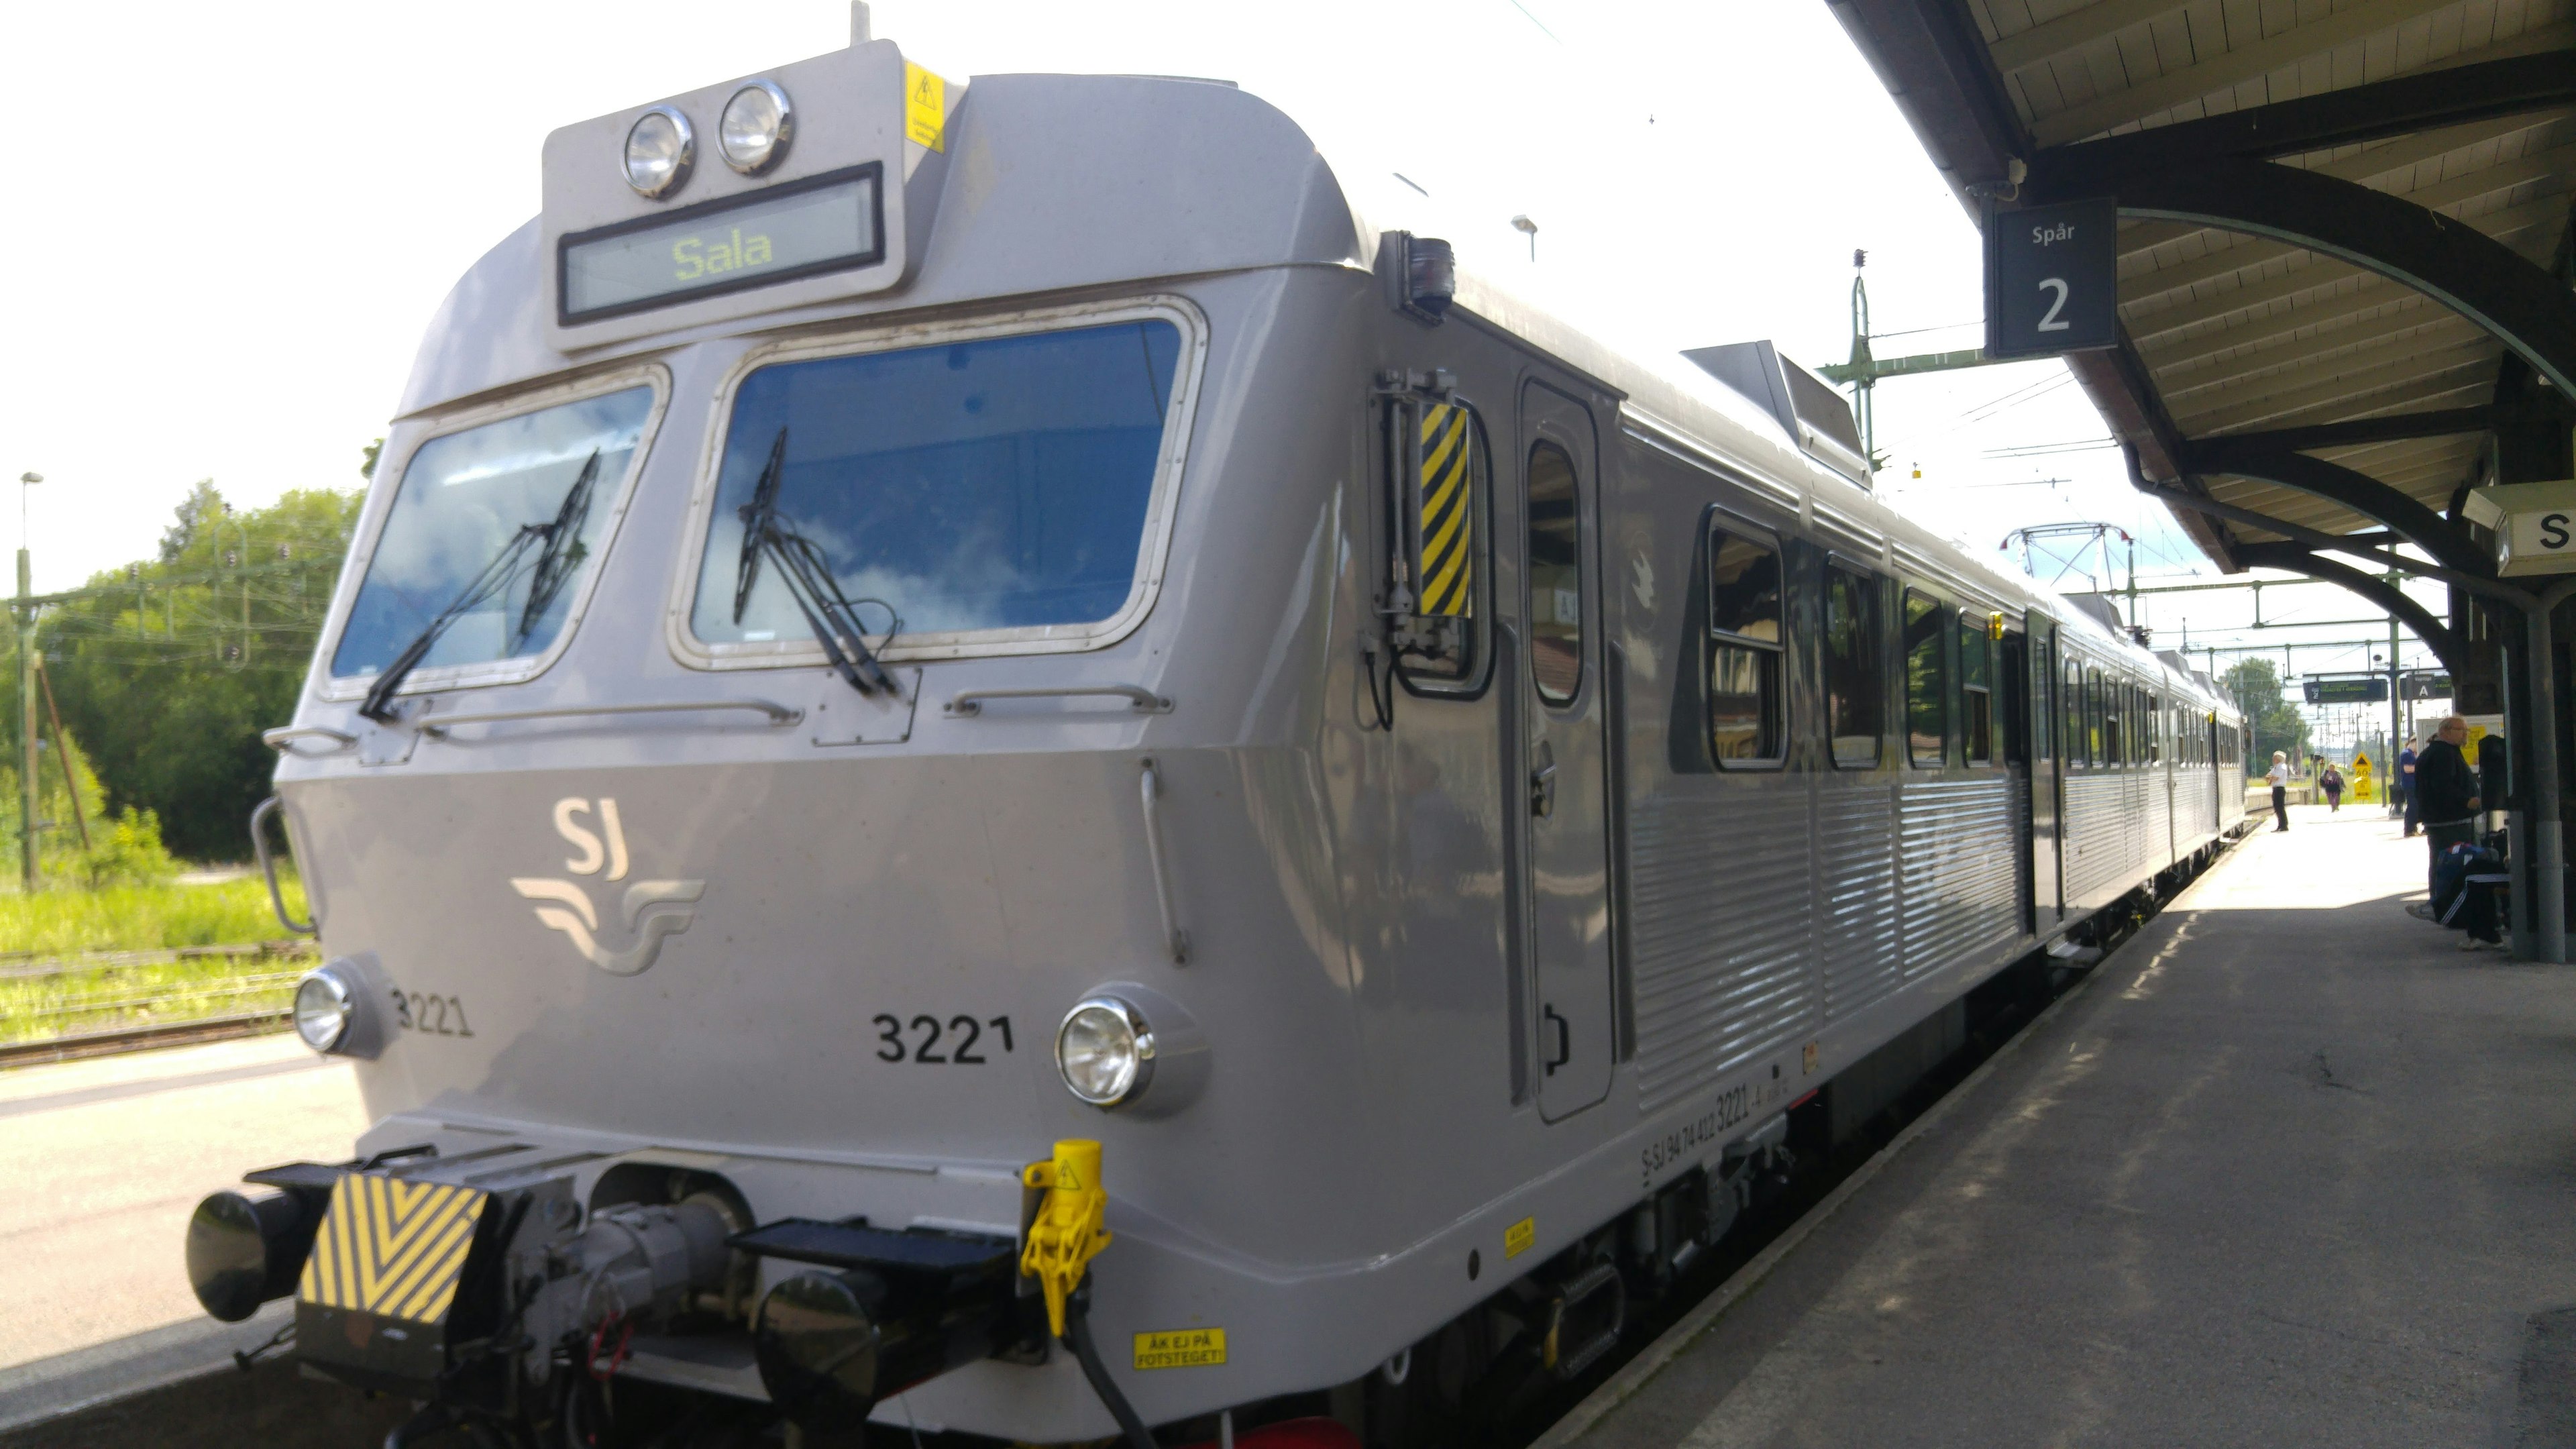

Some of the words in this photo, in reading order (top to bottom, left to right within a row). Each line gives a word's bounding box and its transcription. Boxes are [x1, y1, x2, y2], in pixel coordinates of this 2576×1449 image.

[673, 228, 773, 281] Sala
[2033, 221, 2075, 246] Spår
[2037, 277, 2070, 332] 2
[2540, 514, 2570, 549] S
[2419, 685, 2428, 696] A
[553, 798, 629, 881] SJ
[390, 988, 476, 1037] 3221
[873, 1014, 1013, 1063] 3221
[1716, 1083, 1750, 1132] 3221
[1173, 1336, 1189, 1348] EJ
